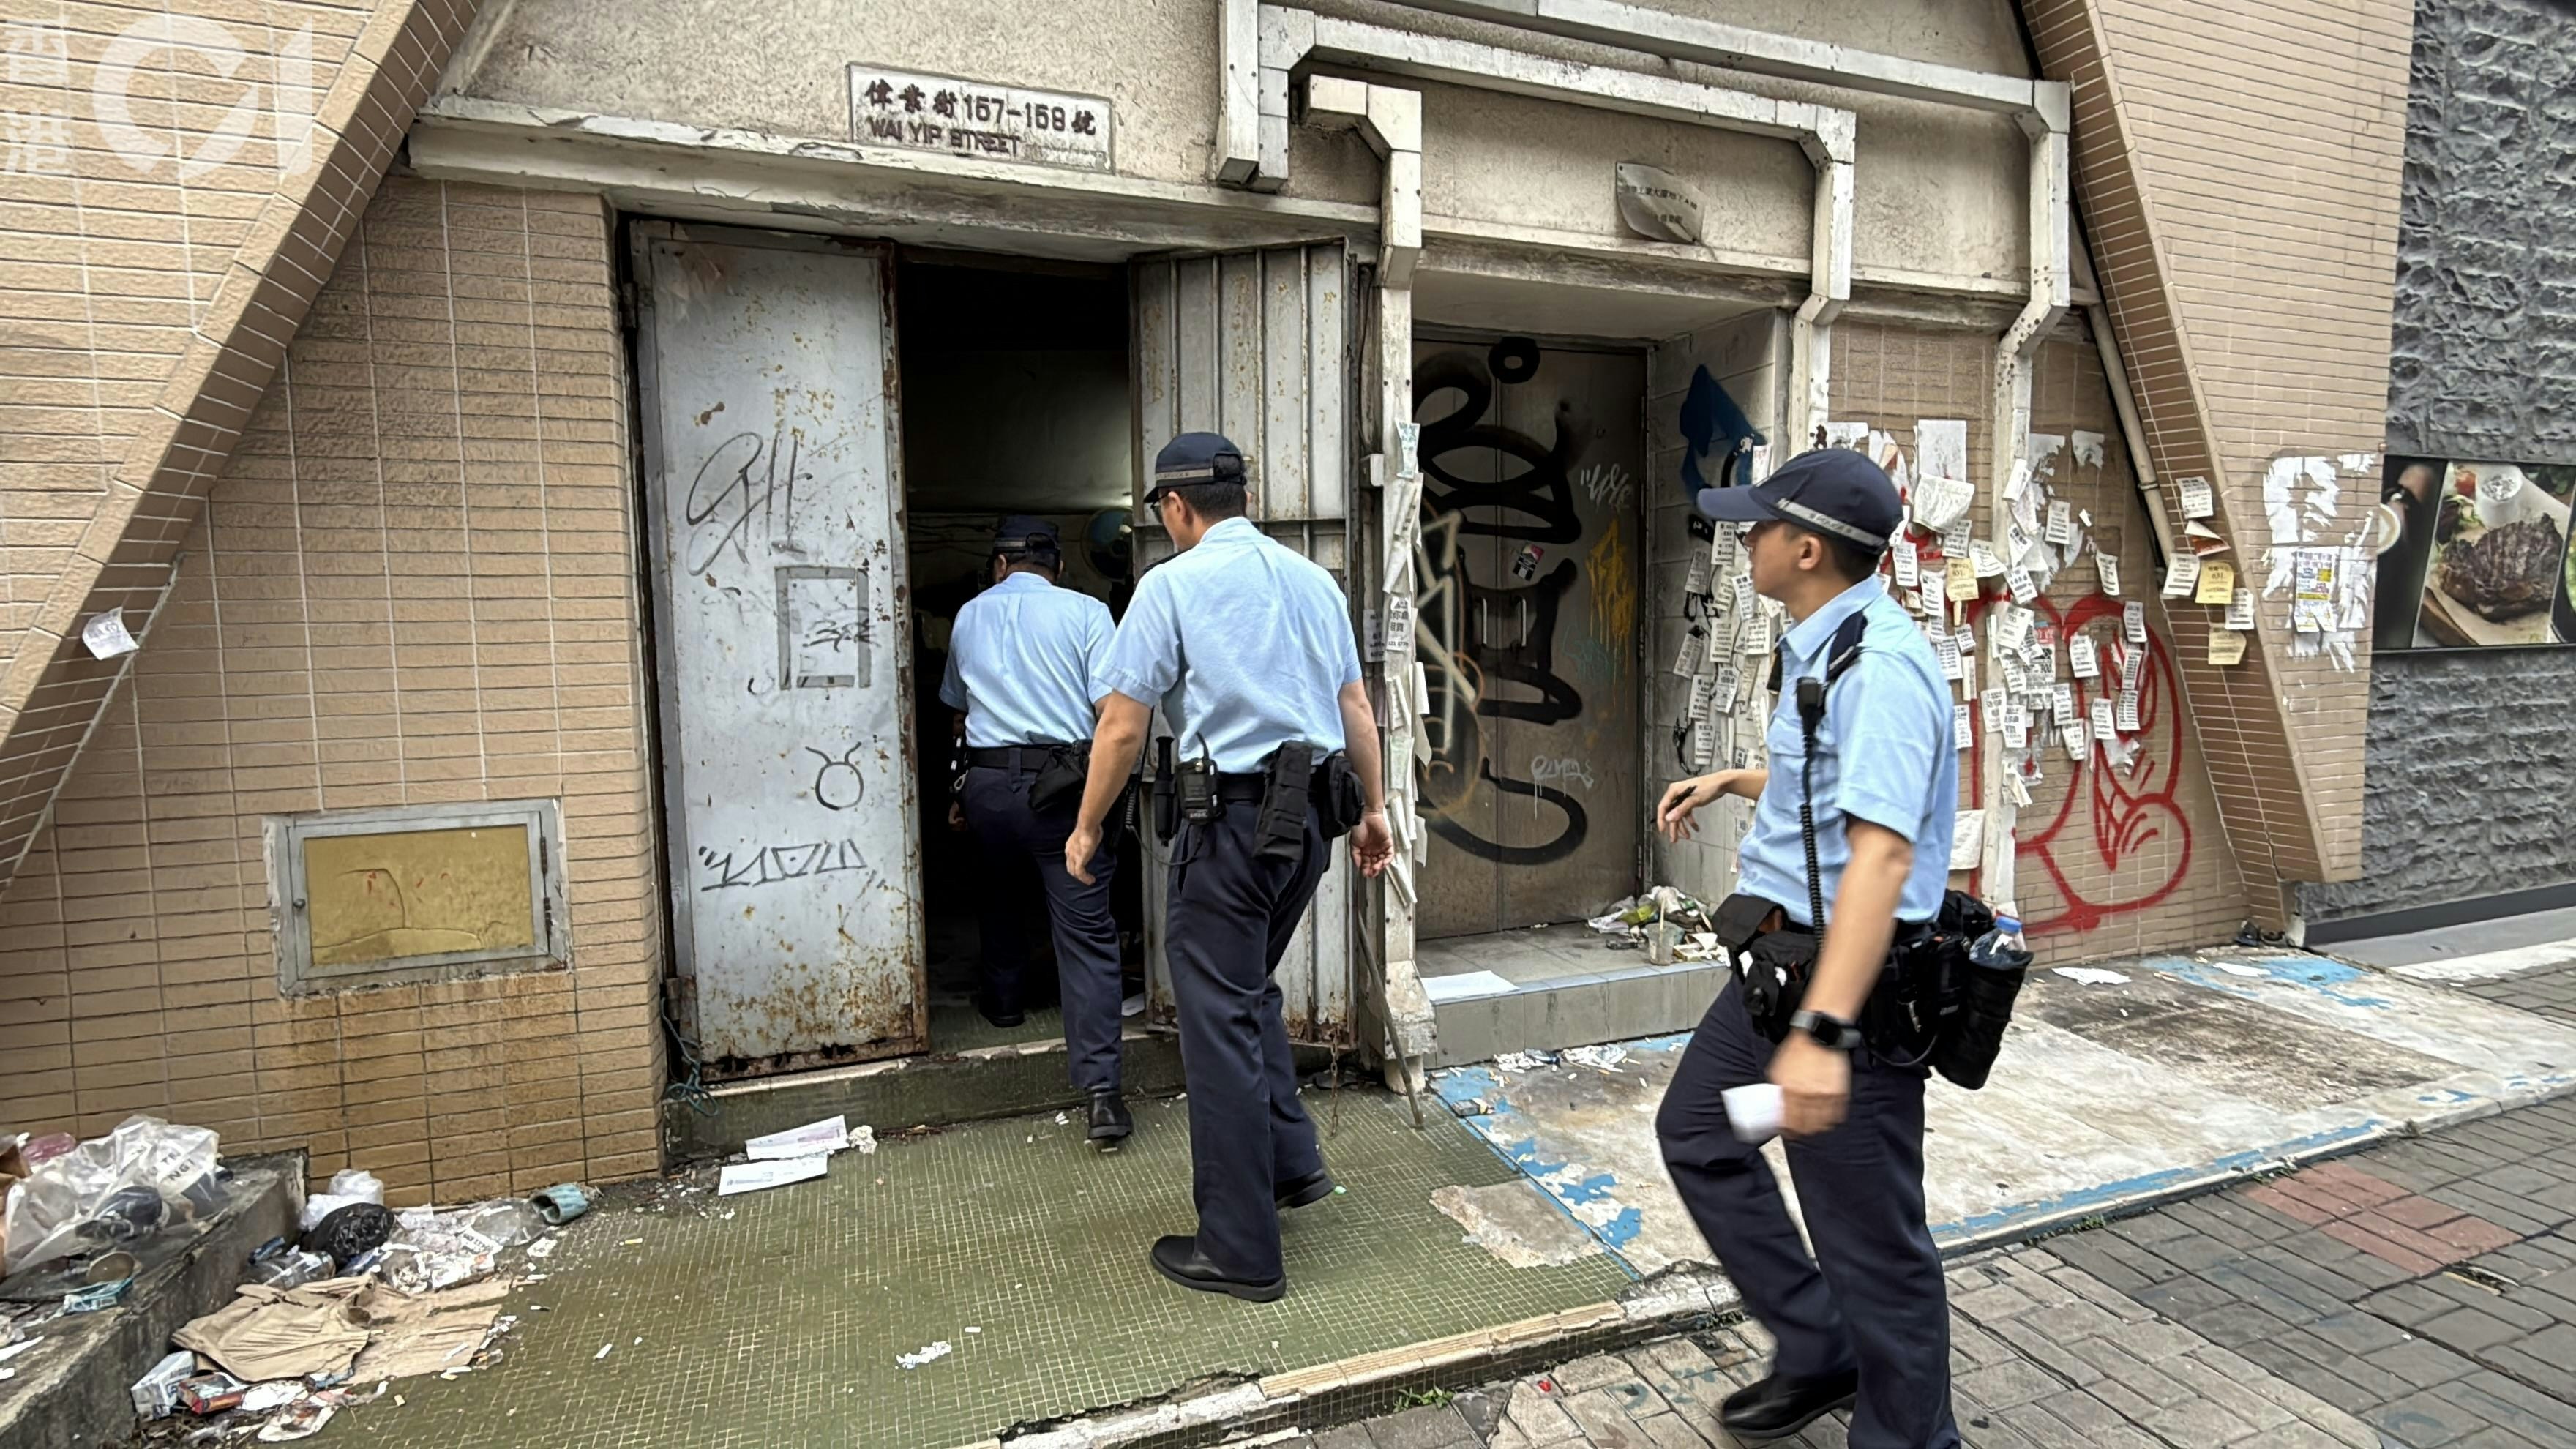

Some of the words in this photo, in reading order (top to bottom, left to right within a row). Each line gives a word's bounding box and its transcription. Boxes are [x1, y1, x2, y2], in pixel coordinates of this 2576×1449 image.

[866, 115, 902, 141] WAI
[908, 121, 943, 144] YIP
[950, 127, 1022, 156] STREET
